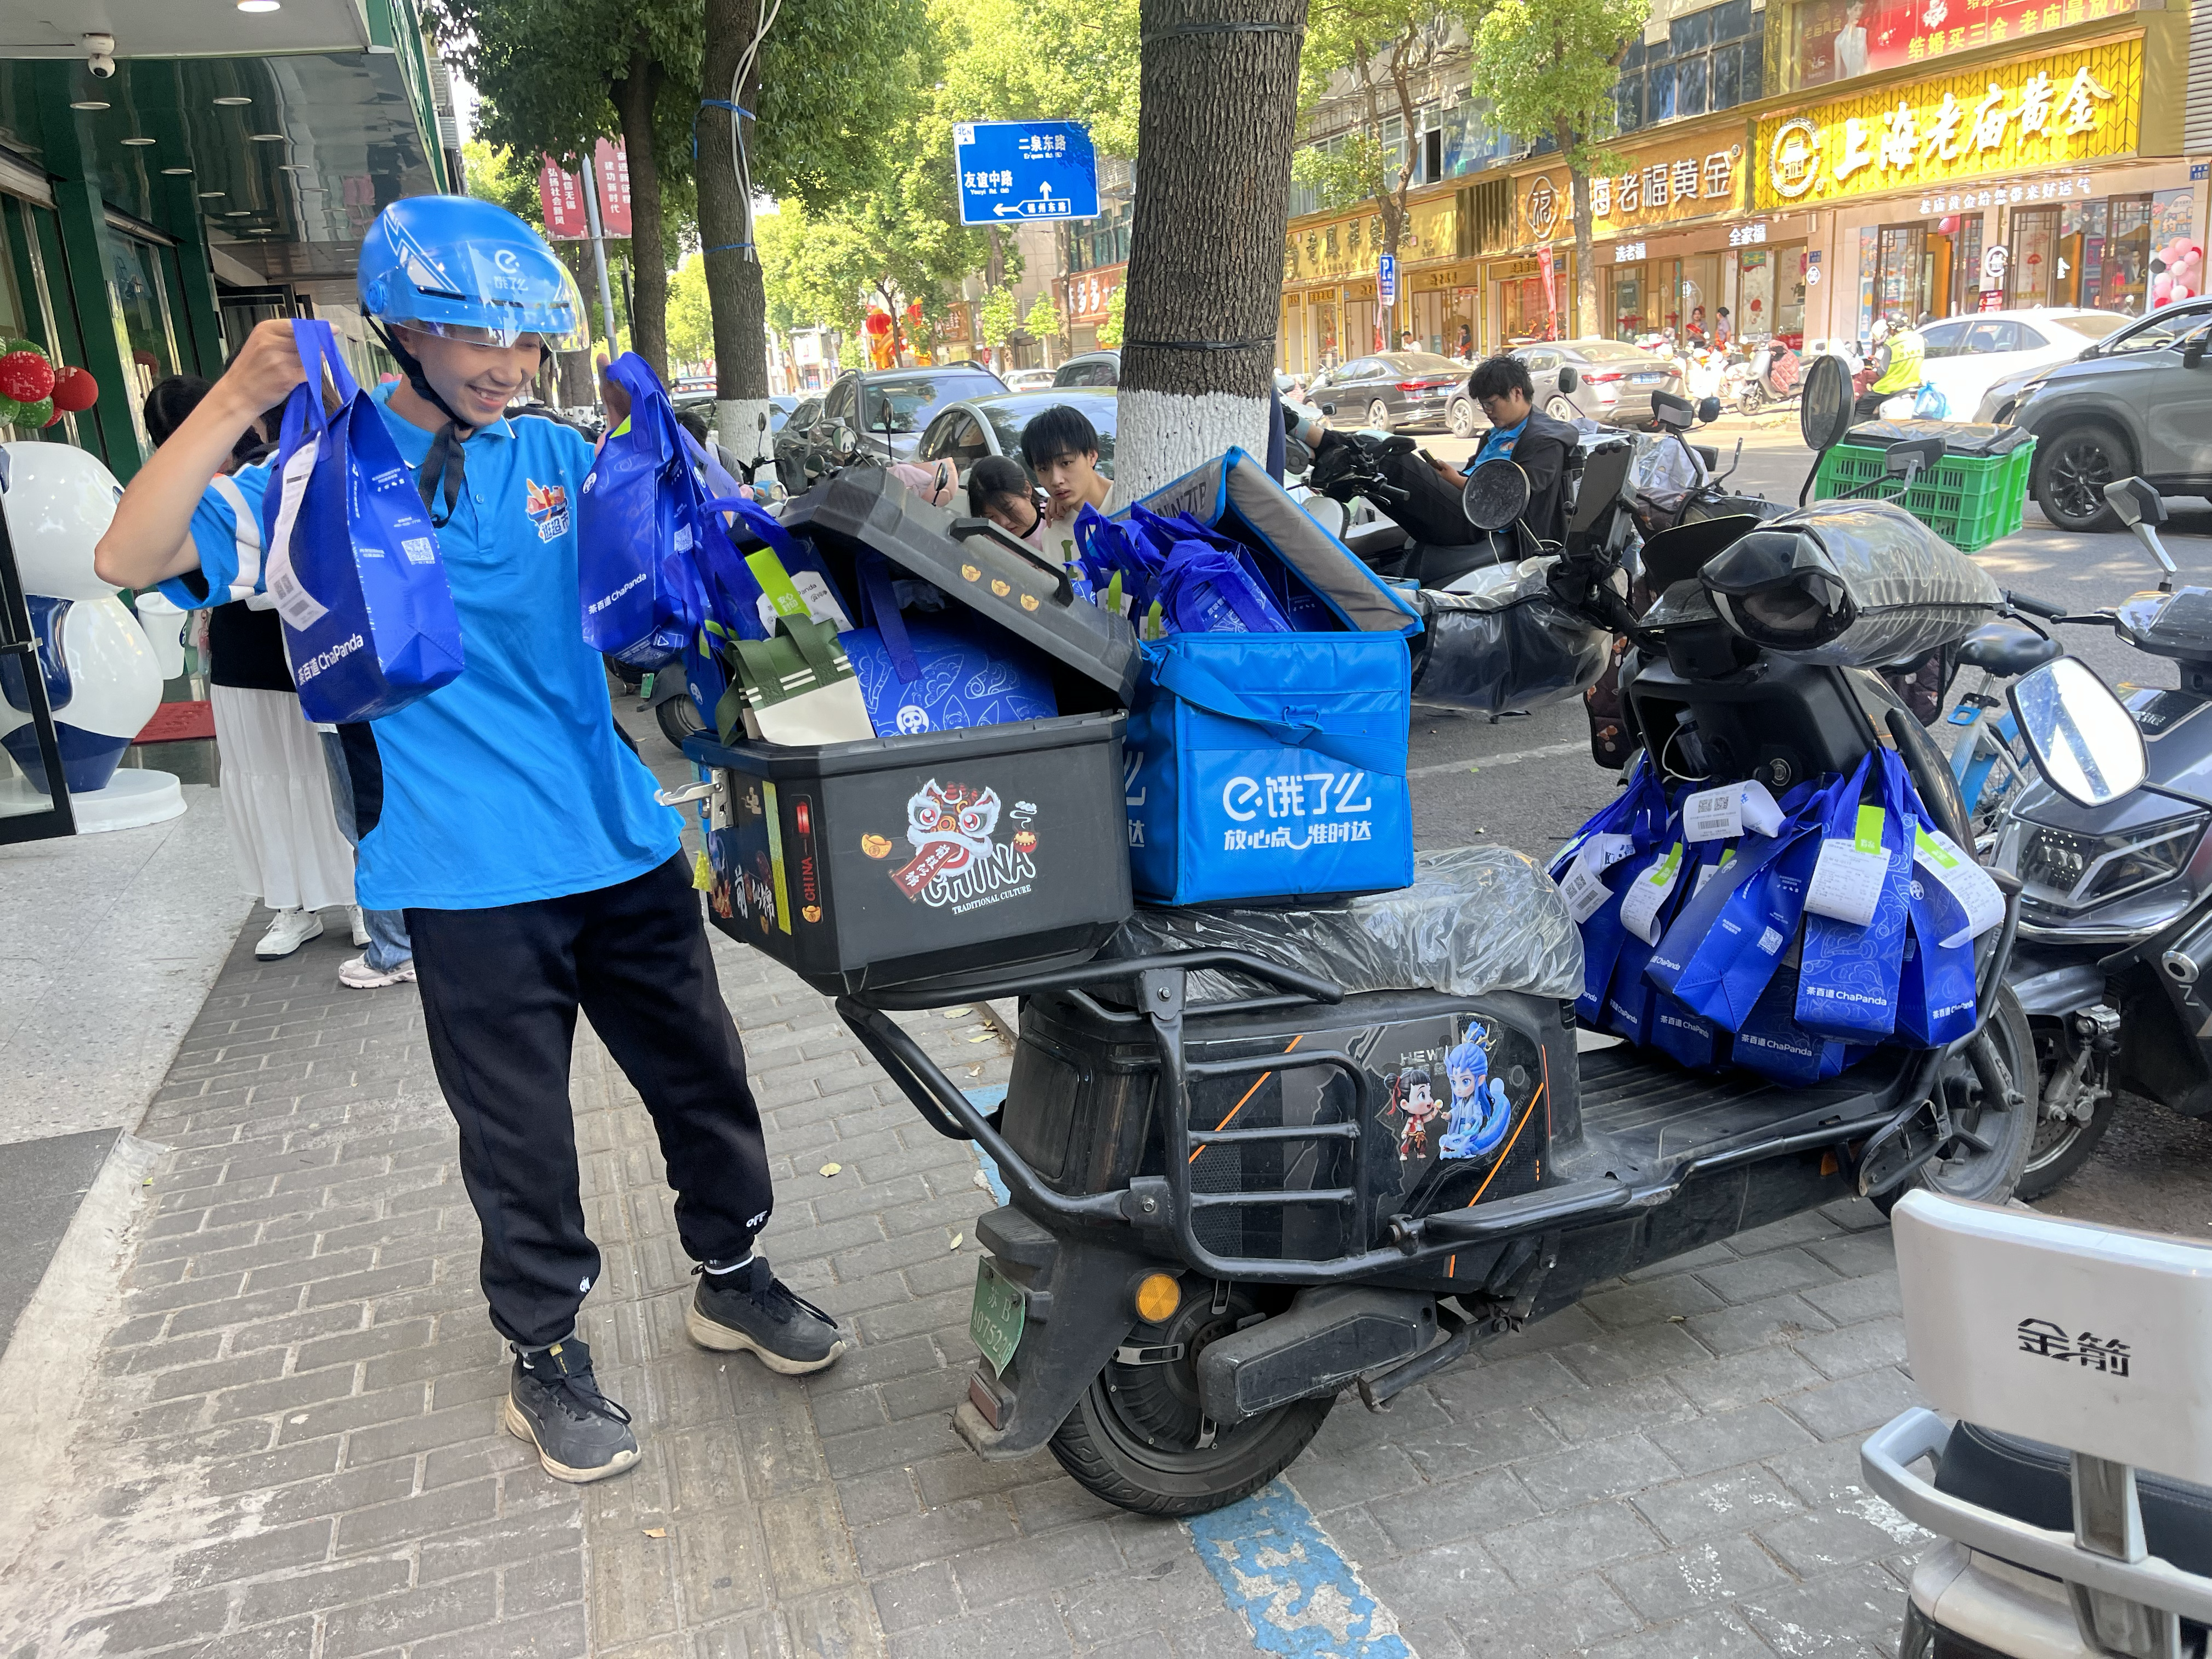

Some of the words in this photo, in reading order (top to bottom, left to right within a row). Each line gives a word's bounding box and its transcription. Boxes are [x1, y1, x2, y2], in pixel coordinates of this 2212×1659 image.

[1908, 16, 2008, 60] 结婚买三金
[957, 126, 967, 136] 北
[1835, 66, 2114, 182] 上海老庙黄金
[1018, 134, 1066, 152] 二泉东路
[605, 161, 620, 213] 建功新时代
[964, 170, 1013, 188] 友谊中路
[547, 168, 565, 225] 弘扬社会新风
[1918, 177, 2091, 215] 老庙黄金给您带来好运气
[1728, 224, 1767, 247] 全家福
[1615, 242, 1646, 262] 选老福
[588, 595, 612, 615] 茶百道
[611, 573, 647, 601] ChaPanda
[777, 592, 794, 605] 安心
[297, 657, 321, 686] 茶百道
[318, 633, 364, 670] ChaPanda
[1265, 772, 1372, 818] 饿了么
[802, 856, 816, 901] CHINA
[921, 840, 1036, 907] CHINA
[952, 894, 1000, 915] TRADITIONAL
[1000, 884, 1032, 902] CULTURE
[1656, 957, 1681, 971] ChaPanda
[1806, 986, 1835, 999] 茶百道
[1836, 991, 1887, 1006] ChaPanda
[1617, 1005, 1638, 1024] ChaPanda
[1660, 1014, 1682, 1028] 茶百道
[1683, 1021, 1709, 1039] ChaPanda
[1741, 1034, 1766, 1047] 茶百道
[1767, 1040, 1812, 1057] ChaPanda
[746, 1210, 768, 1228] OFF
[1001, 1296, 1012, 1322] B
[2017, 1317, 2131, 1379] 金箭
